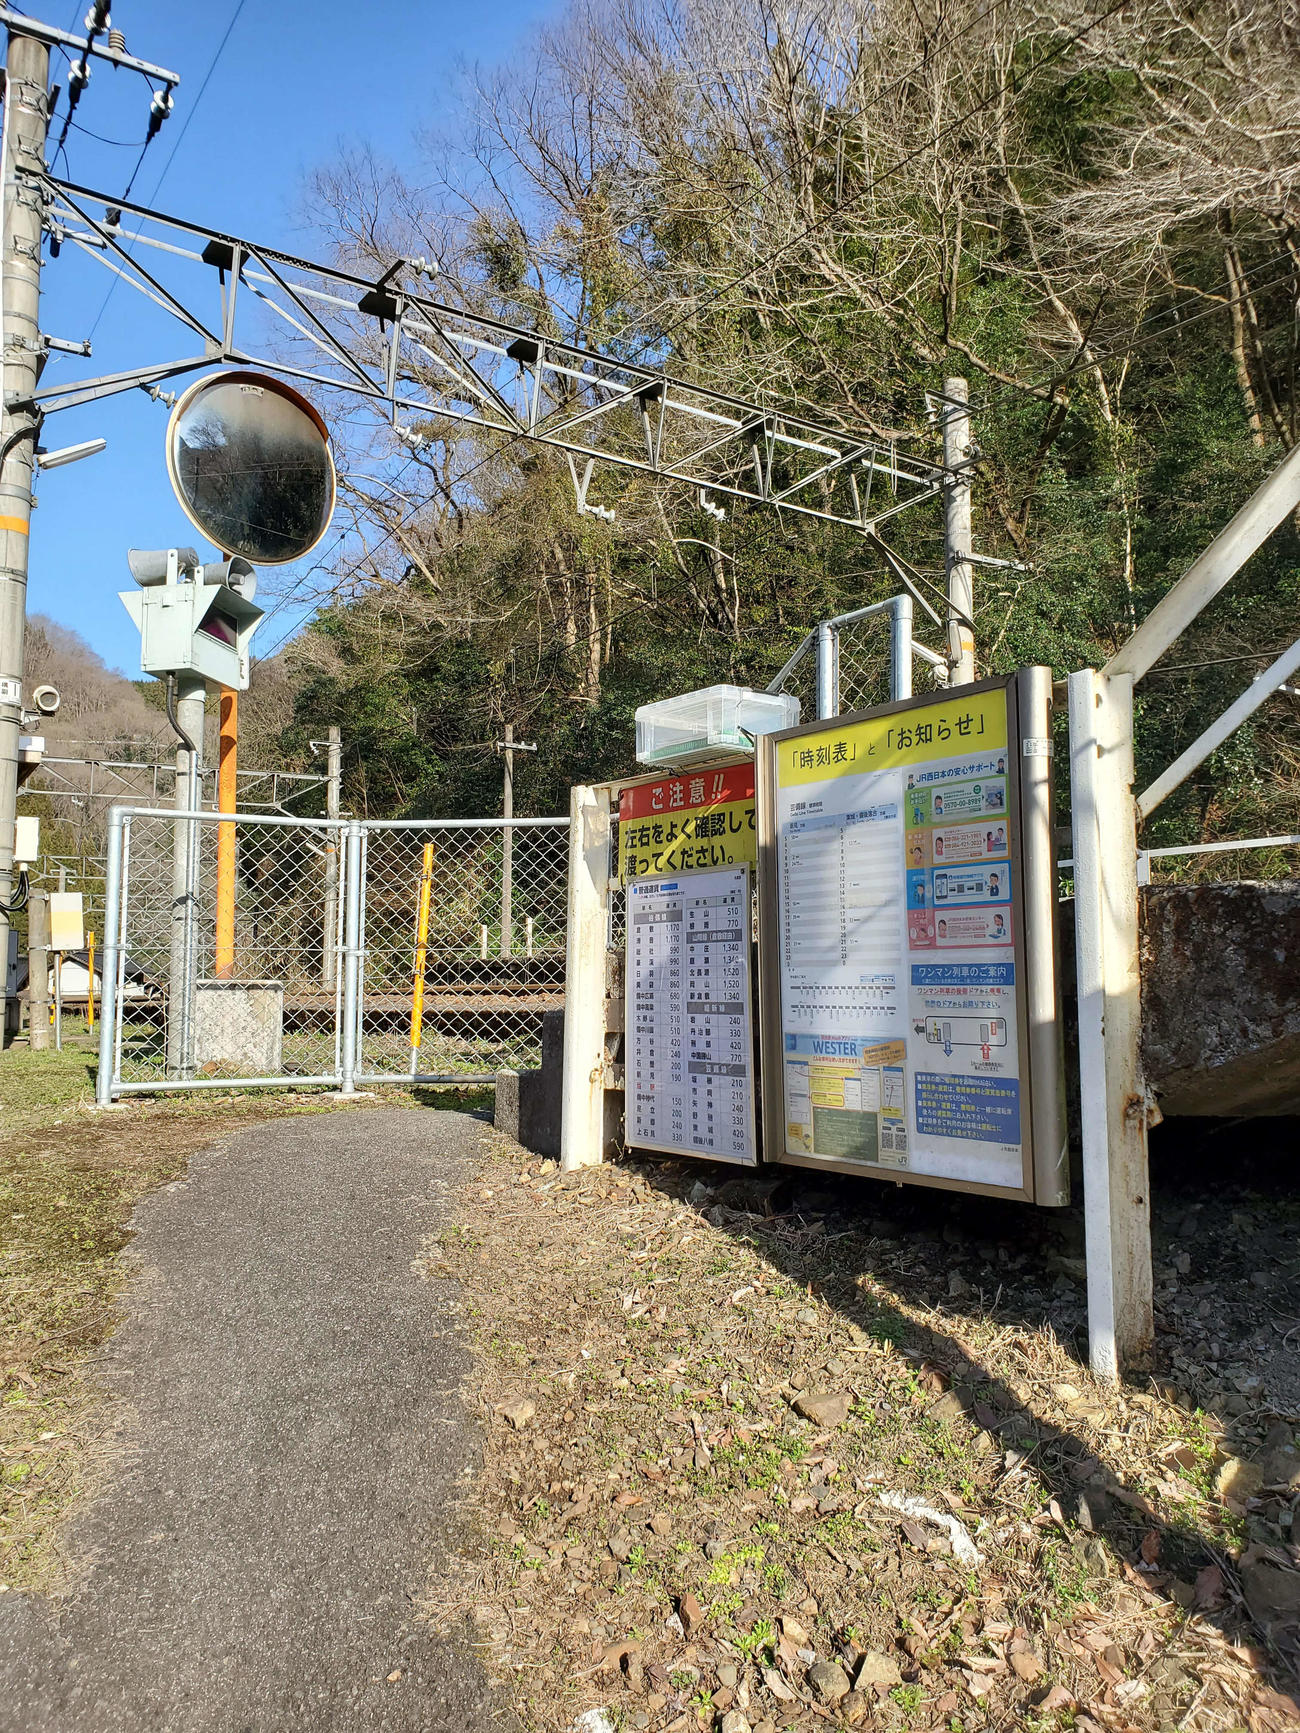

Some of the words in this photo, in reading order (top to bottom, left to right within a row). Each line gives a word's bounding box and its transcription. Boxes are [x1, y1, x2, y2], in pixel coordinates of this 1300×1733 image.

[916, 762, 995, 782] JR西日本の安心サポート
[625, 808, 755, 848] 左右をよく確認して
[625, 845, 734, 876] 渡ってください。
[727, 907, 739, 916] 510
[727, 919, 739, 928] 770
[669, 946, 680, 955] 990
[723, 943, 739, 952] 1,340
[669, 957, 680, 966] 990
[723, 955, 739, 964] 1,340
[669, 969, 680, 977] 860
[723, 968, 739, 976] 1,520
[919, 966, 1006, 977] ワンマン列車のご案内
[669, 980, 680, 989] 860
[723, 980, 740, 989] 1,520
[669, 992, 680, 1000] 680
[723, 992, 740, 1001] 1,340
[670, 1003, 680, 1012] 590
[670, 1015, 680, 1023] 510
[729, 1017, 741, 1025] 240
[670, 1026, 680, 1035] 510
[730, 1029, 741, 1038] 330
[670, 1038, 680, 1047] 420
[730, 1041, 741, 1050] 420
[813, 1040, 857, 1056] WESTER
[670, 1050, 680, 1059] 240
[730, 1053, 742, 1062] 770
[671, 1062, 681, 1070] 200
[671, 1074, 681, 1082] 190
[731, 1079, 743, 1087] 210
[732, 1091, 743, 1100] 210
[672, 1098, 681, 1106] 150
[732, 1104, 743, 1113] 240
[672, 1109, 682, 1118] 200
[672, 1121, 682, 1130] 240
[732, 1117, 743, 1125] 330
[672, 1133, 683, 1142] 330
[732, 1129, 744, 1138] 420
[732, 1142, 745, 1151] 590
